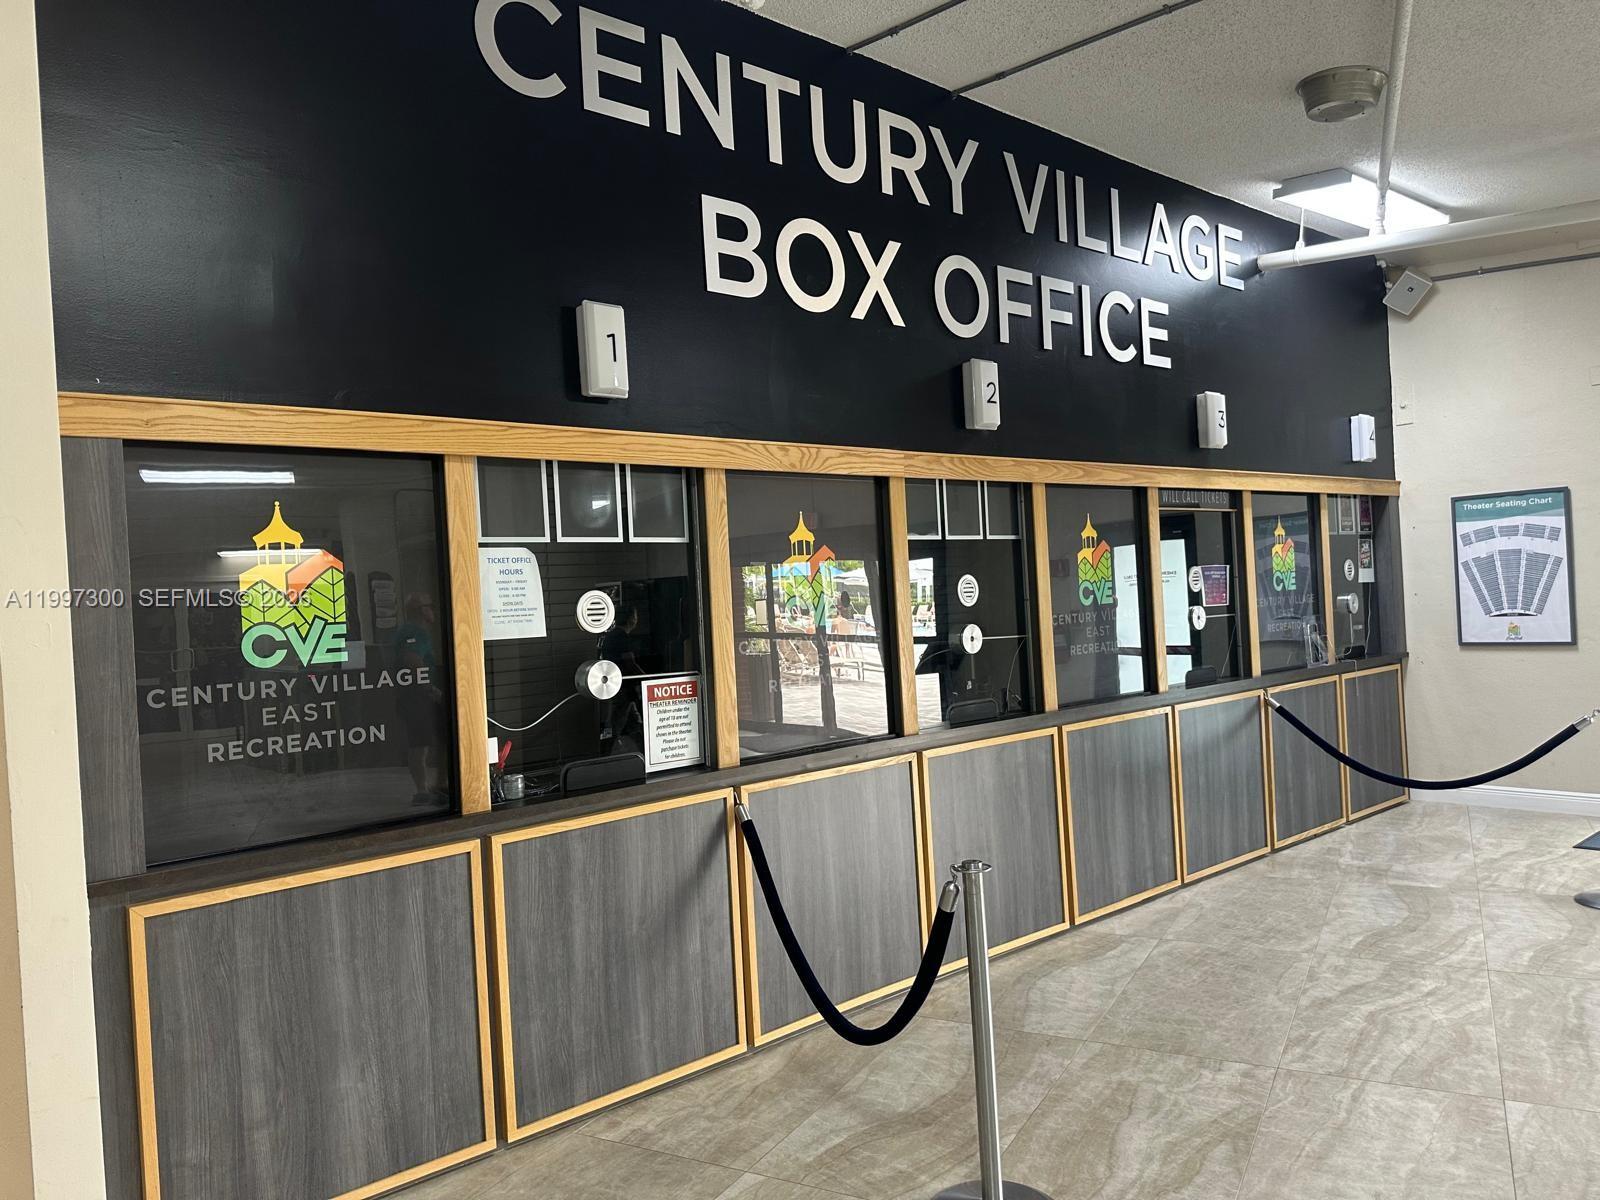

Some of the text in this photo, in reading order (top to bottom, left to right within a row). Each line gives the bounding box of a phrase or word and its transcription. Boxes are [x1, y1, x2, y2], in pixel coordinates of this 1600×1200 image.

[475, 0, 1245, 291] CENTURY VILLAGE
[701, 194, 1172, 369] BOX OFFICE
[606, 333, 617, 363] 1
[986, 382, 998, 404] 2
[1218, 410, 1225, 428] 3
[1463, 497, 1553, 511] Theater Seating Chart
[1079, 577, 1114, 606] CVE
[1273, 570, 1297, 591] CVE
[1052, 611, 1098, 626] CENTURY
[241, 615, 348, 669] CVE
[1086, 625, 1111, 638] EAST
[146, 667, 431, 709] CENTURY VILLAGE
[654, 684, 693, 698] NOTICE
[262, 701, 336, 726] EAST
[649, 697, 697, 708] THEATER REMINDER
[207, 724, 386, 763] RECREATION
